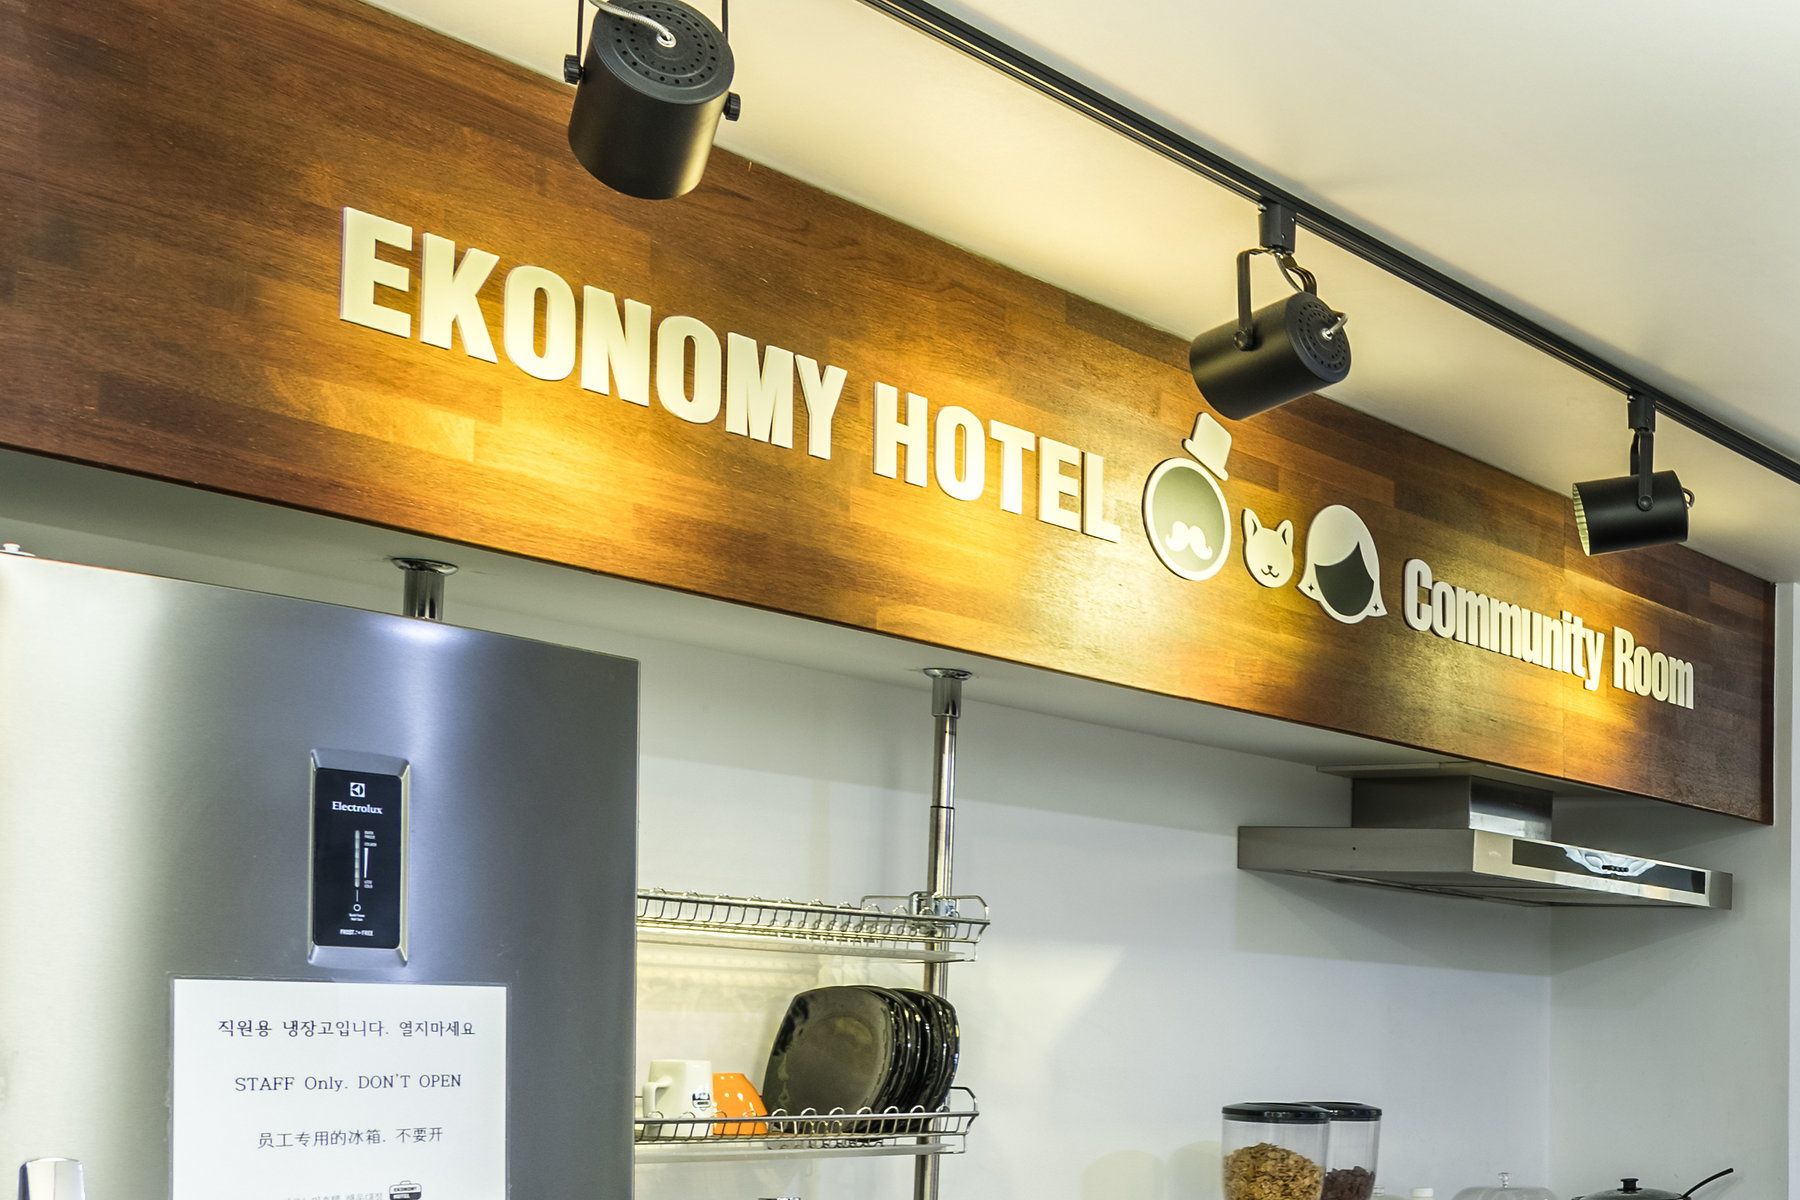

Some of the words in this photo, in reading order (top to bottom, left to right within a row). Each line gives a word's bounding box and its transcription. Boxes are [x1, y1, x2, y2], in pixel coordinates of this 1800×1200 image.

[340, 206, 847, 460] EKONOMY
[873, 380, 1121, 543] HOTEL
[1404, 557, 1605, 691] Community
[1613, 625, 1695, 710] Room
[332, 801, 383, 815] Electrolux
[218, 1019, 273, 1038] 직원용
[283, 1019, 389, 1038] 냉장고입니다.
[399, 1020, 476, 1037] 열지마세요
[235, 1076, 295, 1091] STAFF
[304, 1076, 349, 1092] Only.
[357, 1073, 411, 1090] DON'T
[419, 1073, 462, 1088] OPEN
